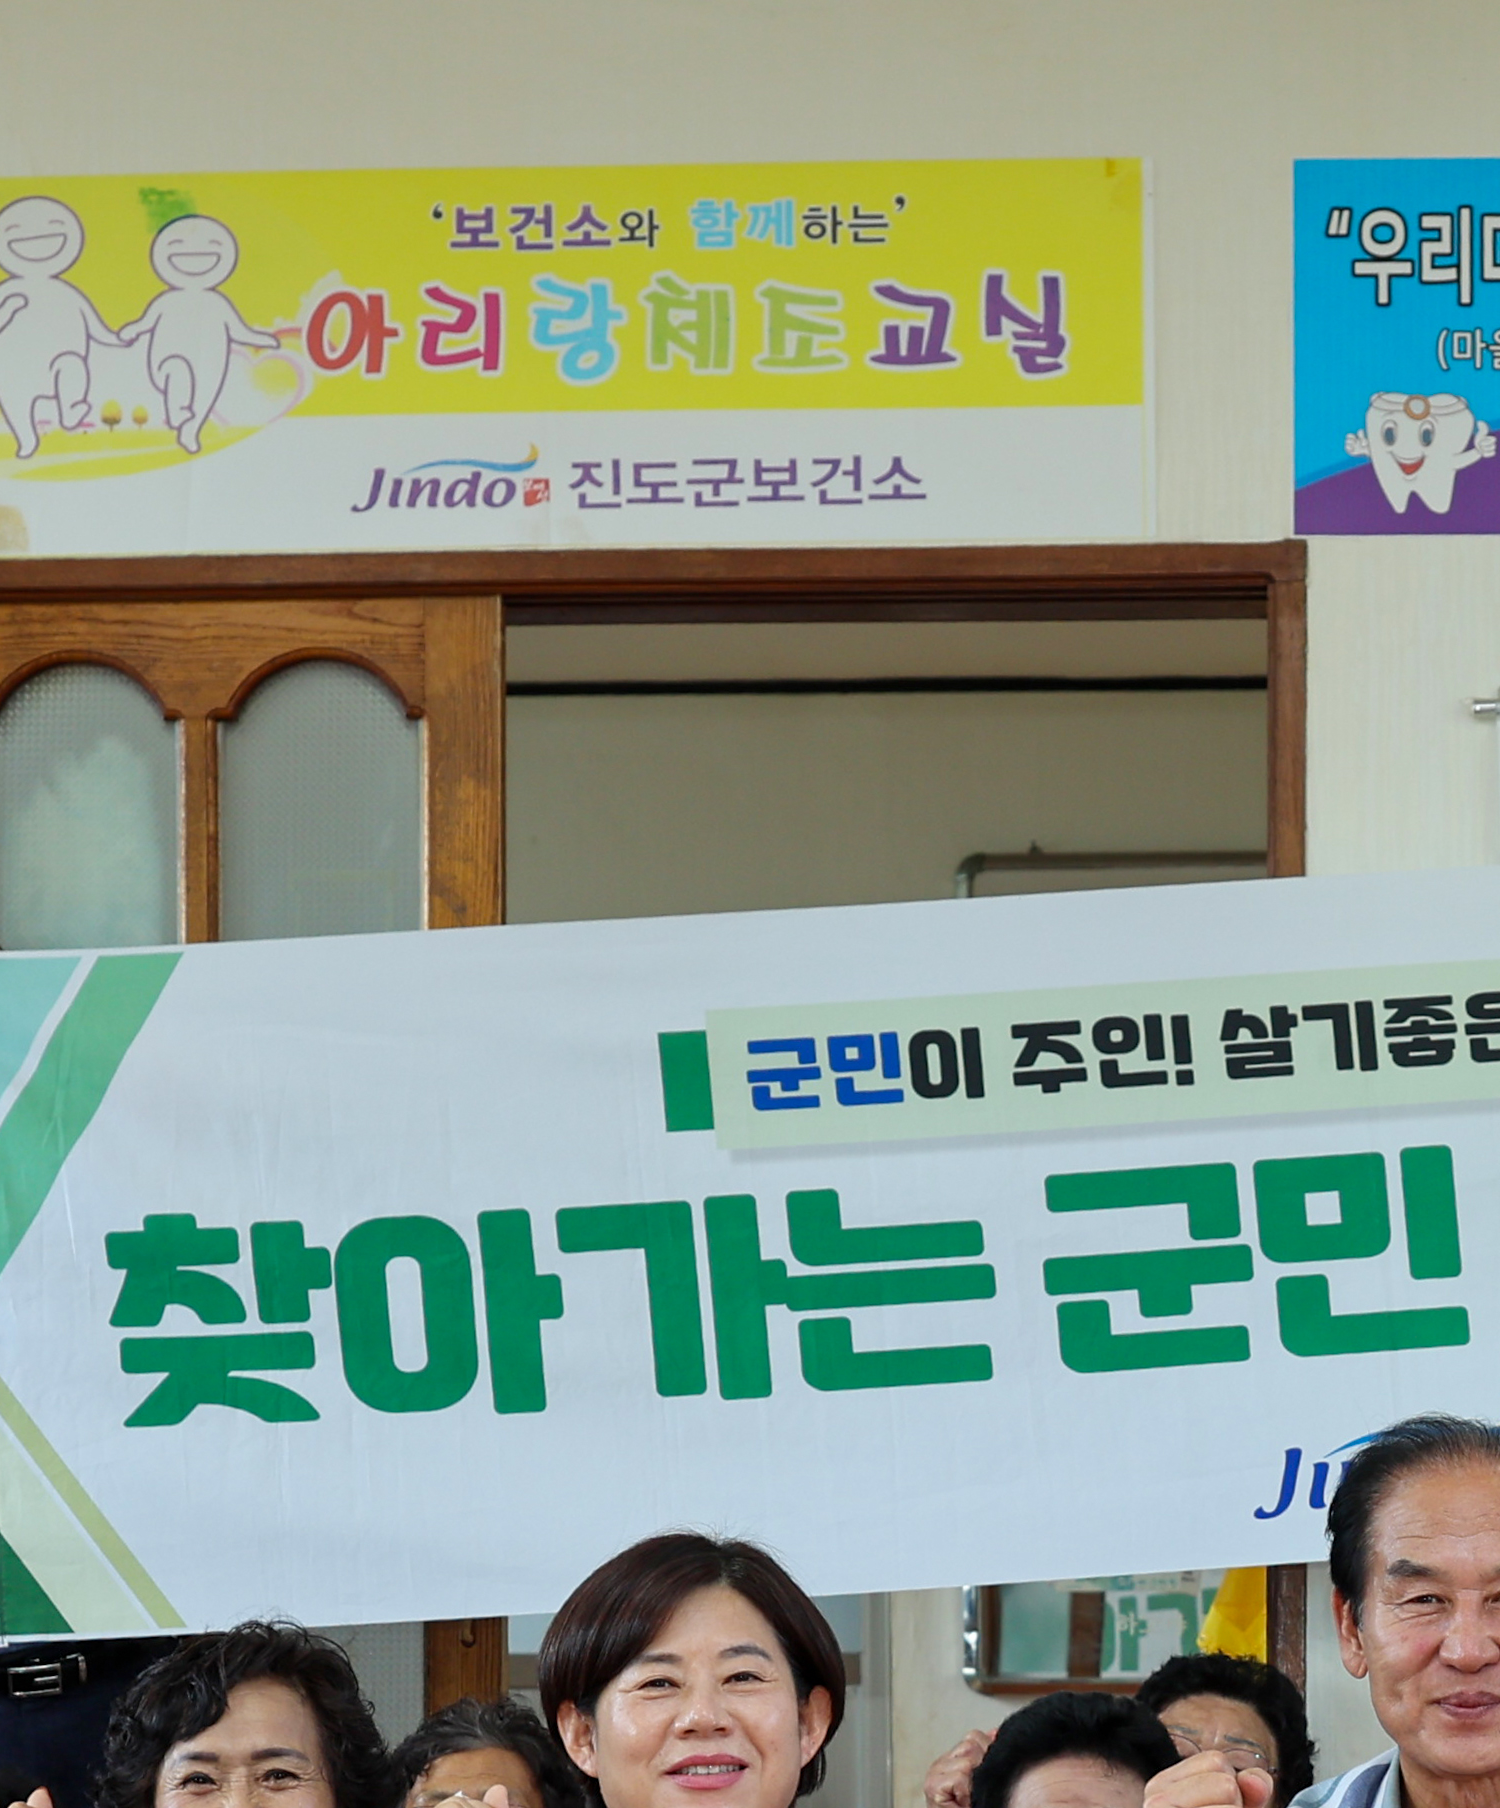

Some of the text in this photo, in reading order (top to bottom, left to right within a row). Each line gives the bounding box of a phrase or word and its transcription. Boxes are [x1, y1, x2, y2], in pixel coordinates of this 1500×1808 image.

[350, 467, 517, 513] Jindo
[568, 455, 927, 513] 진도군보건소
[746, 1025, 985, 1111] 군민이
[1011, 1013, 1195, 1095] 주인!
[102, 1187, 997, 1428] 찾아가는
[1042, 1142, 1471, 1375] 군민
